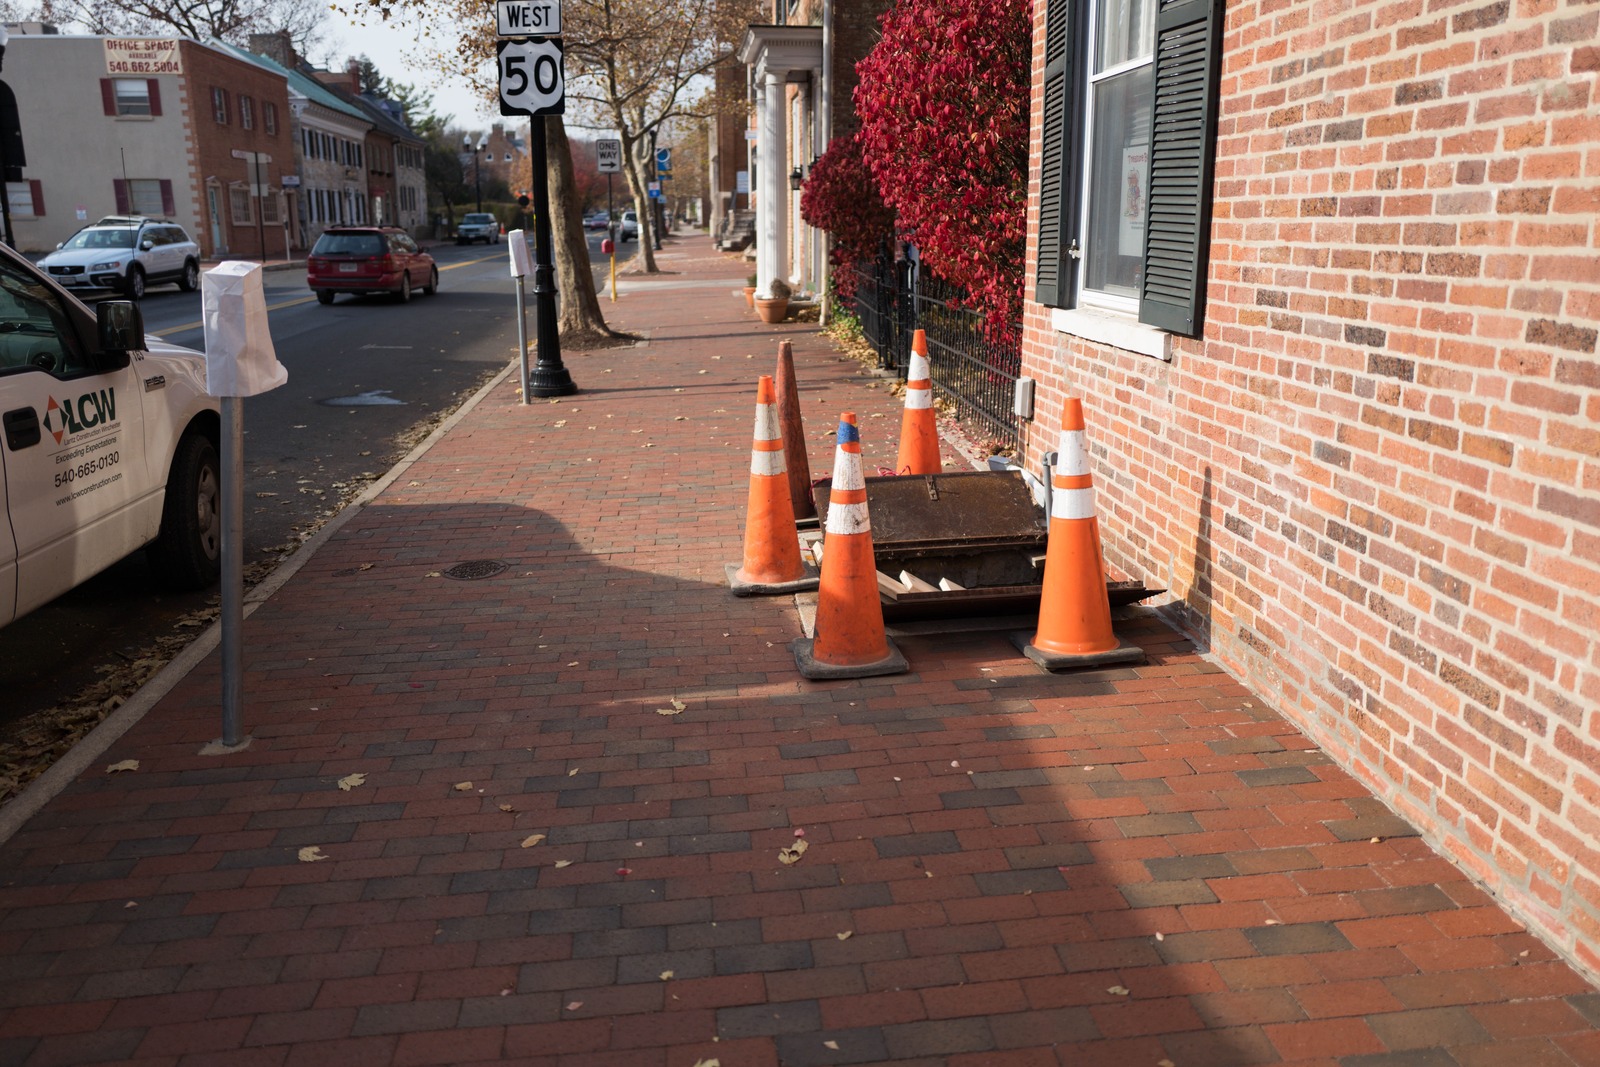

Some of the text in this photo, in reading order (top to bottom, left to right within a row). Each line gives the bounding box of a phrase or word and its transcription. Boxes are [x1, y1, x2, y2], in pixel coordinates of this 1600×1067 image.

[506, 5, 551, 27] WEST
[107, 40, 175, 51] OFFICE SPACE
[505, 54, 558, 96] 50
[598, 142, 616, 151] ONE
[598, 151, 617, 159] WAY
[63, 387, 116, 434] LCW
[63, 421, 121, 446] Lantz Construction Winchester
[55, 437, 117, 464] Exceeding Expectations
[55, 473, 122, 506] www.lcwconstruction.com
